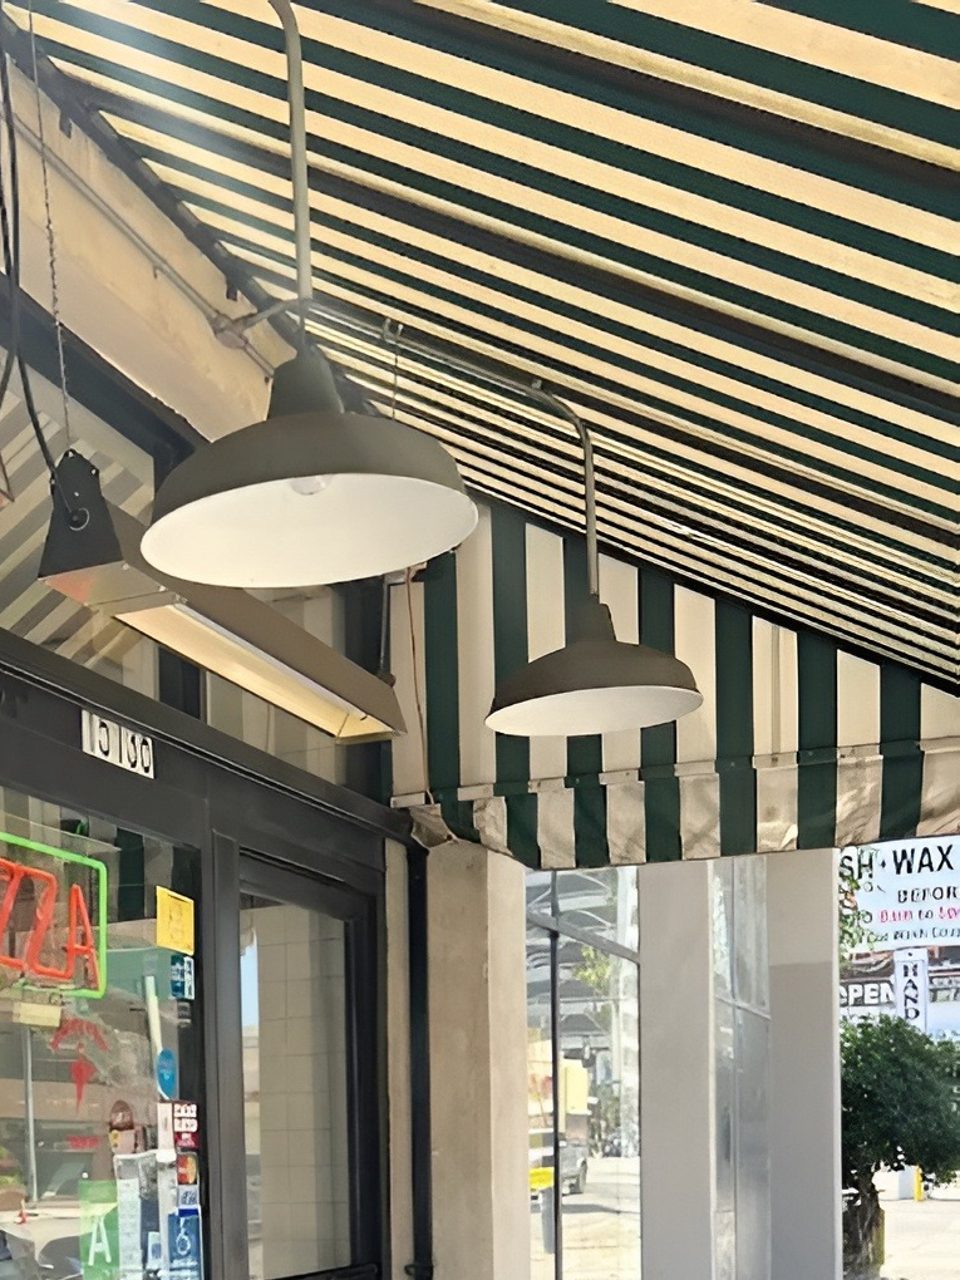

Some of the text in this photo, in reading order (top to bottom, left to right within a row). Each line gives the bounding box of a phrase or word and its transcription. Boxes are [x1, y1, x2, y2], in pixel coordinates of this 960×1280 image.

[893, 844, 954, 875] WAX
[903, 964, 920, 1019] HAND
[88, 1215, 112, 1266] A
